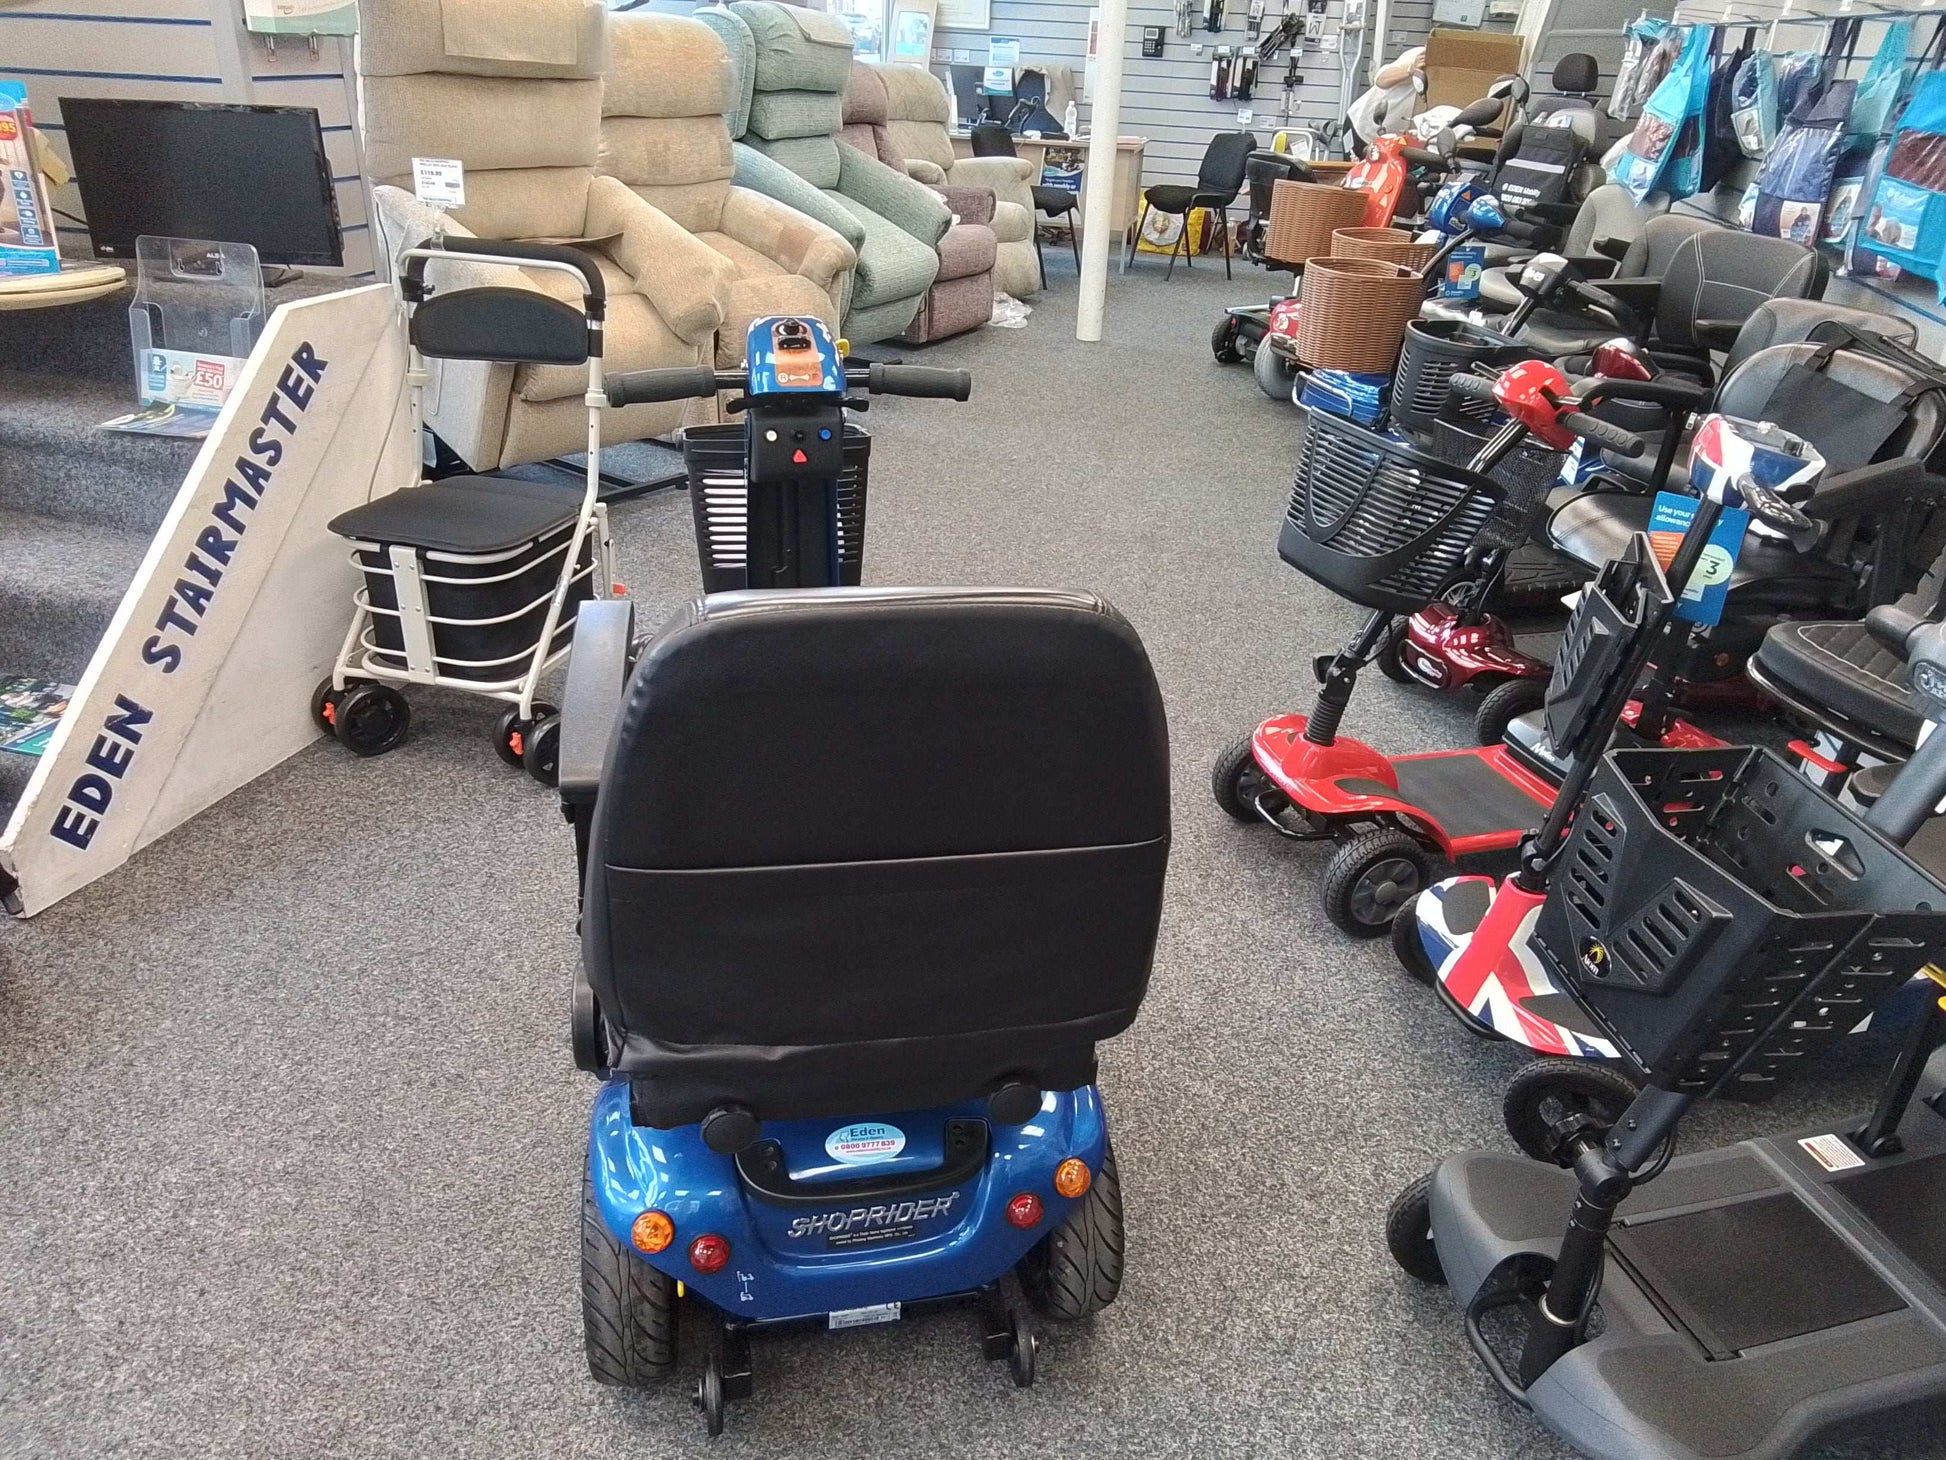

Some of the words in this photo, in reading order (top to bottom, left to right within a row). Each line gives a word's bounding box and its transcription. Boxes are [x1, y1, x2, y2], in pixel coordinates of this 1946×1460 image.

[193, 371, 223, 389] £50
[1658, 504, 1673, 514] Use
[1673, 508, 1690, 519] your
[1655, 514, 1691, 527] allowanc
[1705, 560, 1721, 575] 3
[50, 693, 154, 851] EDEN
[142, 340, 330, 675] STAIRMASTER
[849, 1127, 886, 1137] Eden
